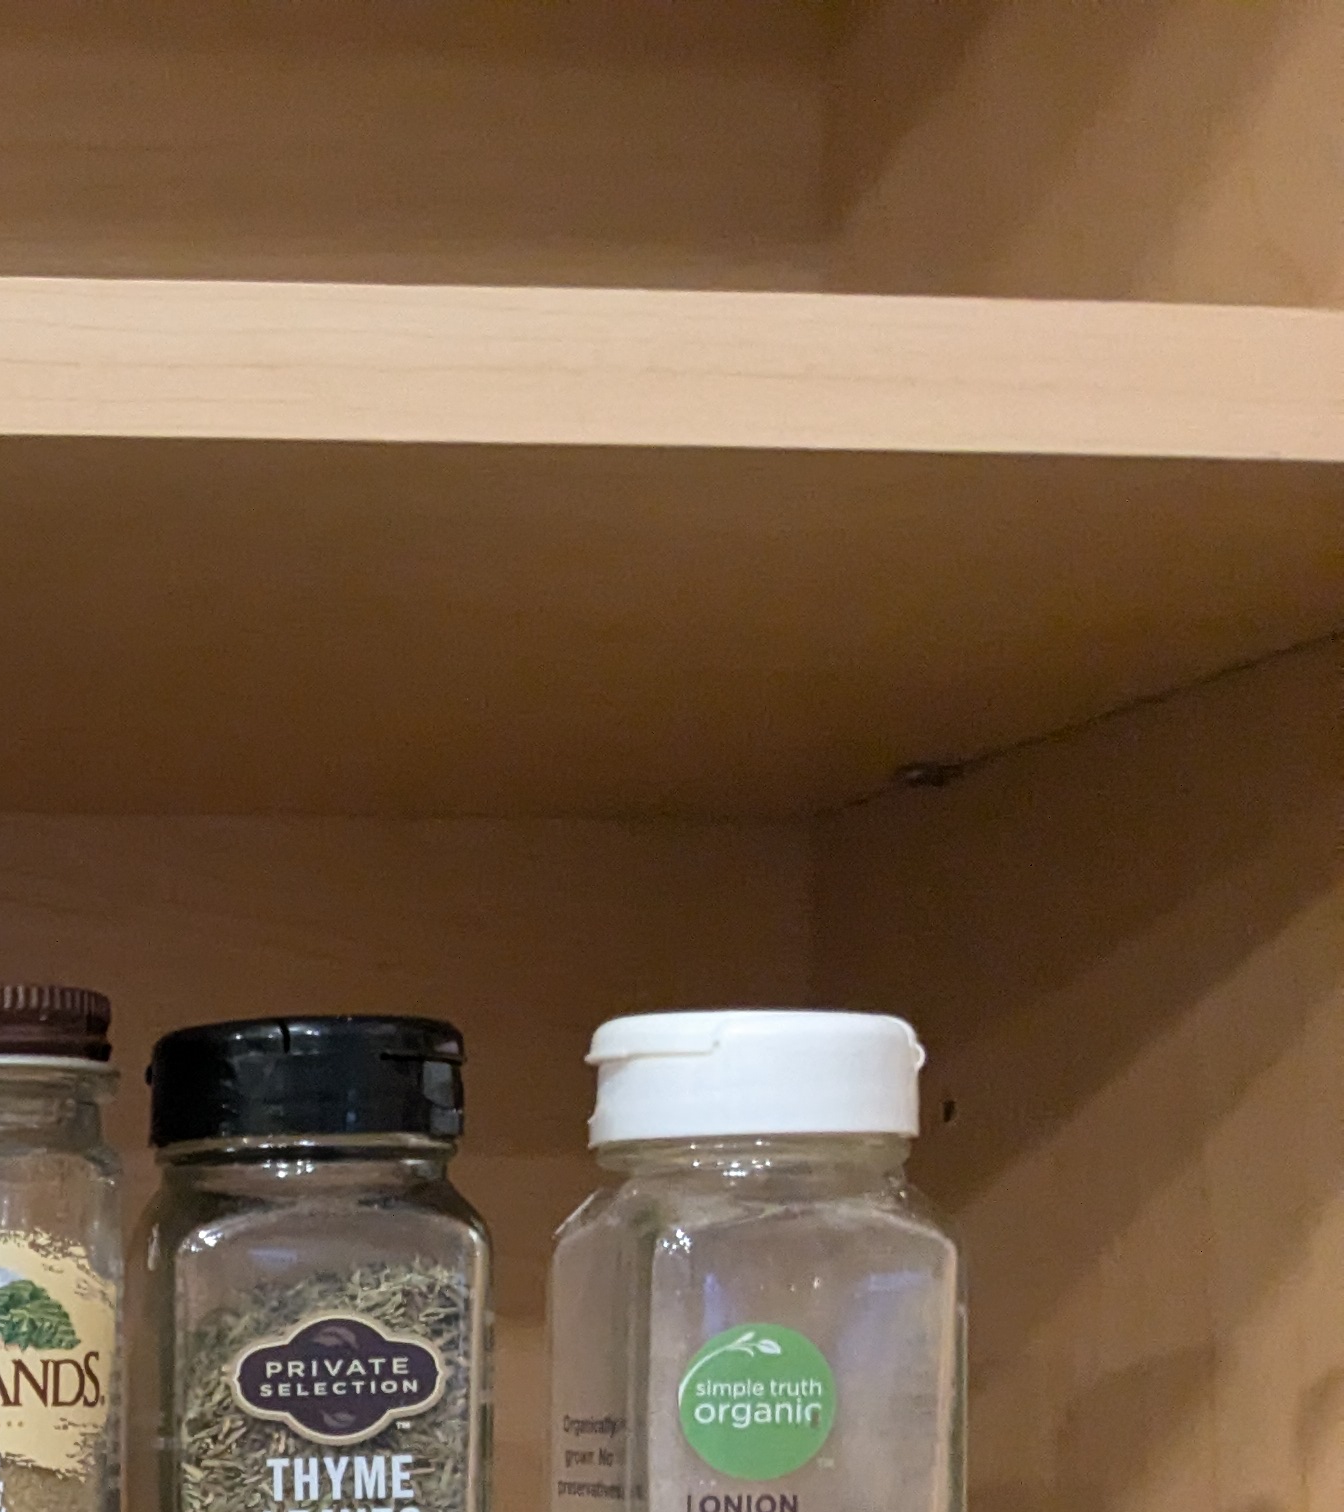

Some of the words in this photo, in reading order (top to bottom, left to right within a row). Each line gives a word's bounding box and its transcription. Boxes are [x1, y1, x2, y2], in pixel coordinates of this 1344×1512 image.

[265, 1357, 410, 1378] PRIVATE
[259, 1380, 418, 1397] SELECTION
[695, 1379, 764, 1398] simple
[770, 1379, 822, 1396] truth
[694, 1399, 821, 1429] organic
[266, 1455, 414, 1502] THYME
